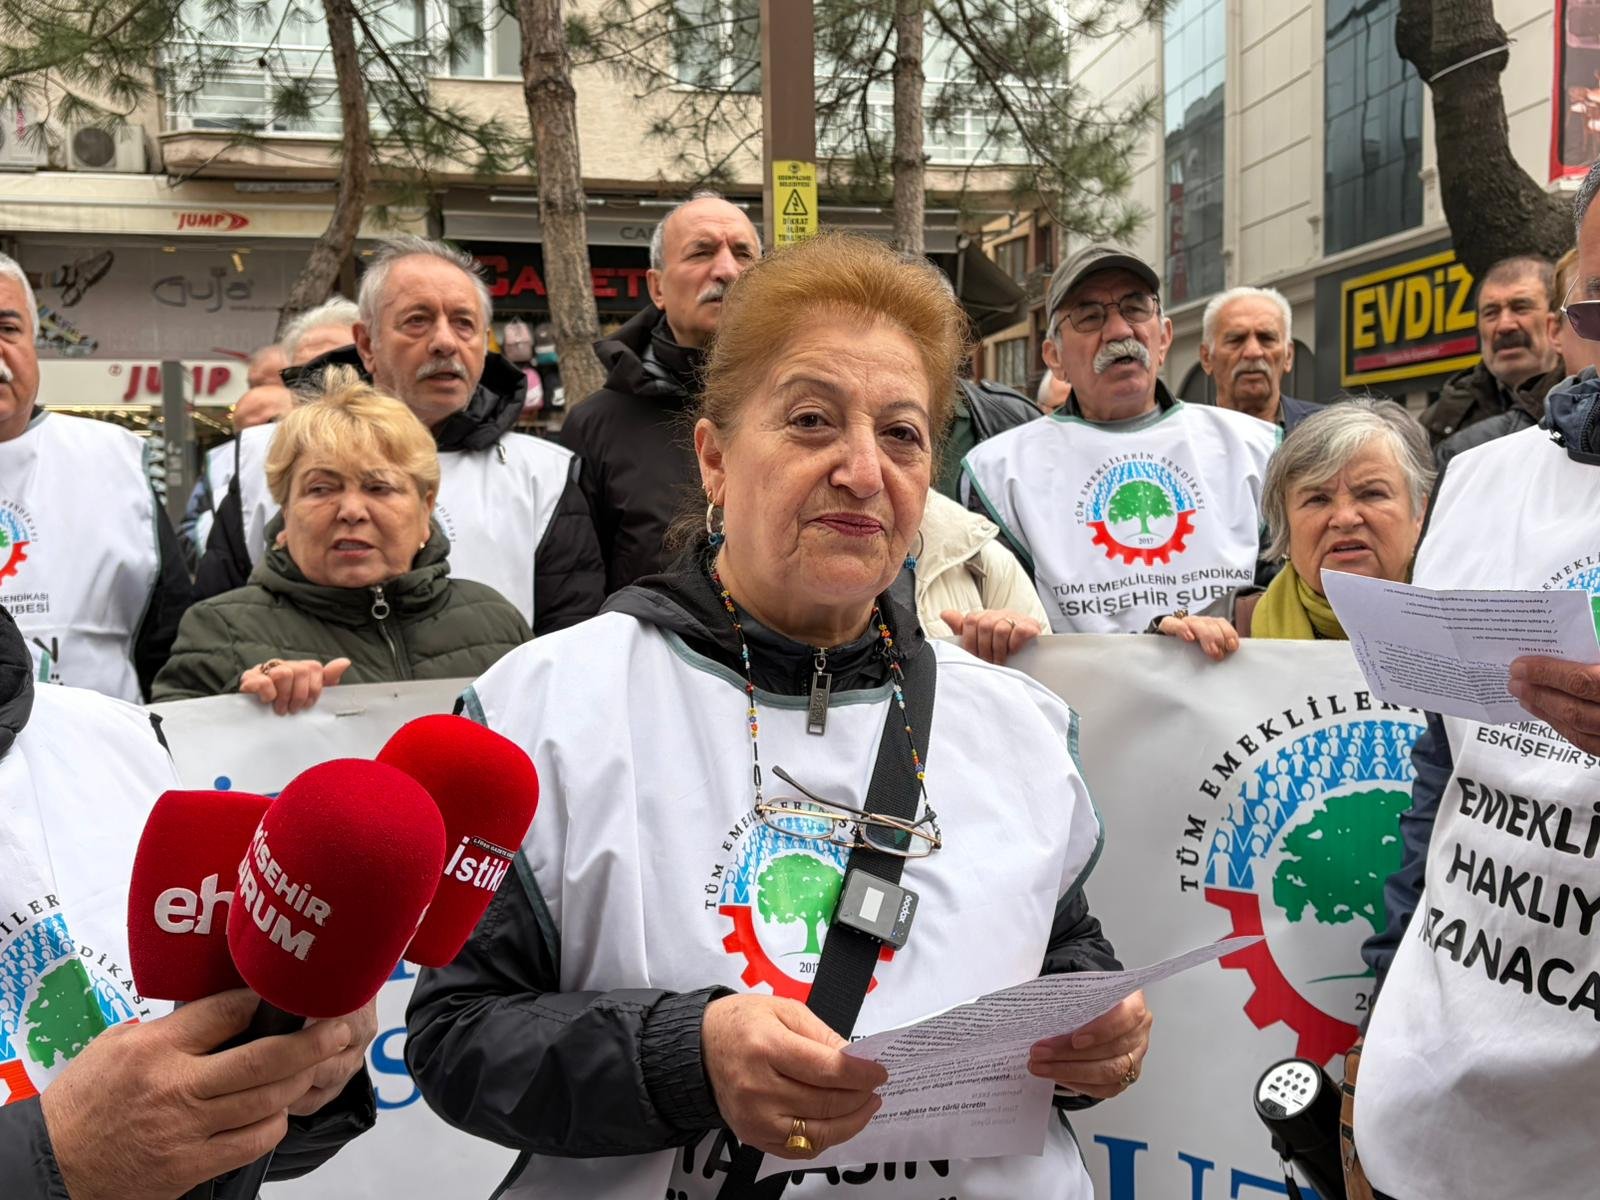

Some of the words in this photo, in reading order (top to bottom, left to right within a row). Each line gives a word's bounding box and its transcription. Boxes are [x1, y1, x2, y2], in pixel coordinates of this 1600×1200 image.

[177, 212, 224, 230] JUMP
[1052, 583, 1085, 597] TÜM
[1089, 573, 1177, 593] EMEKLİLERİN
[1181, 567, 1254, 584] SENDİKASI
[1058, 590, 1169, 616] ESKİŞEHİR
[1476, 726, 1582, 765] ESKİŞEHİR
[1176, 814, 1207, 892] TÜM
[705, 863, 724, 910] TÜM
